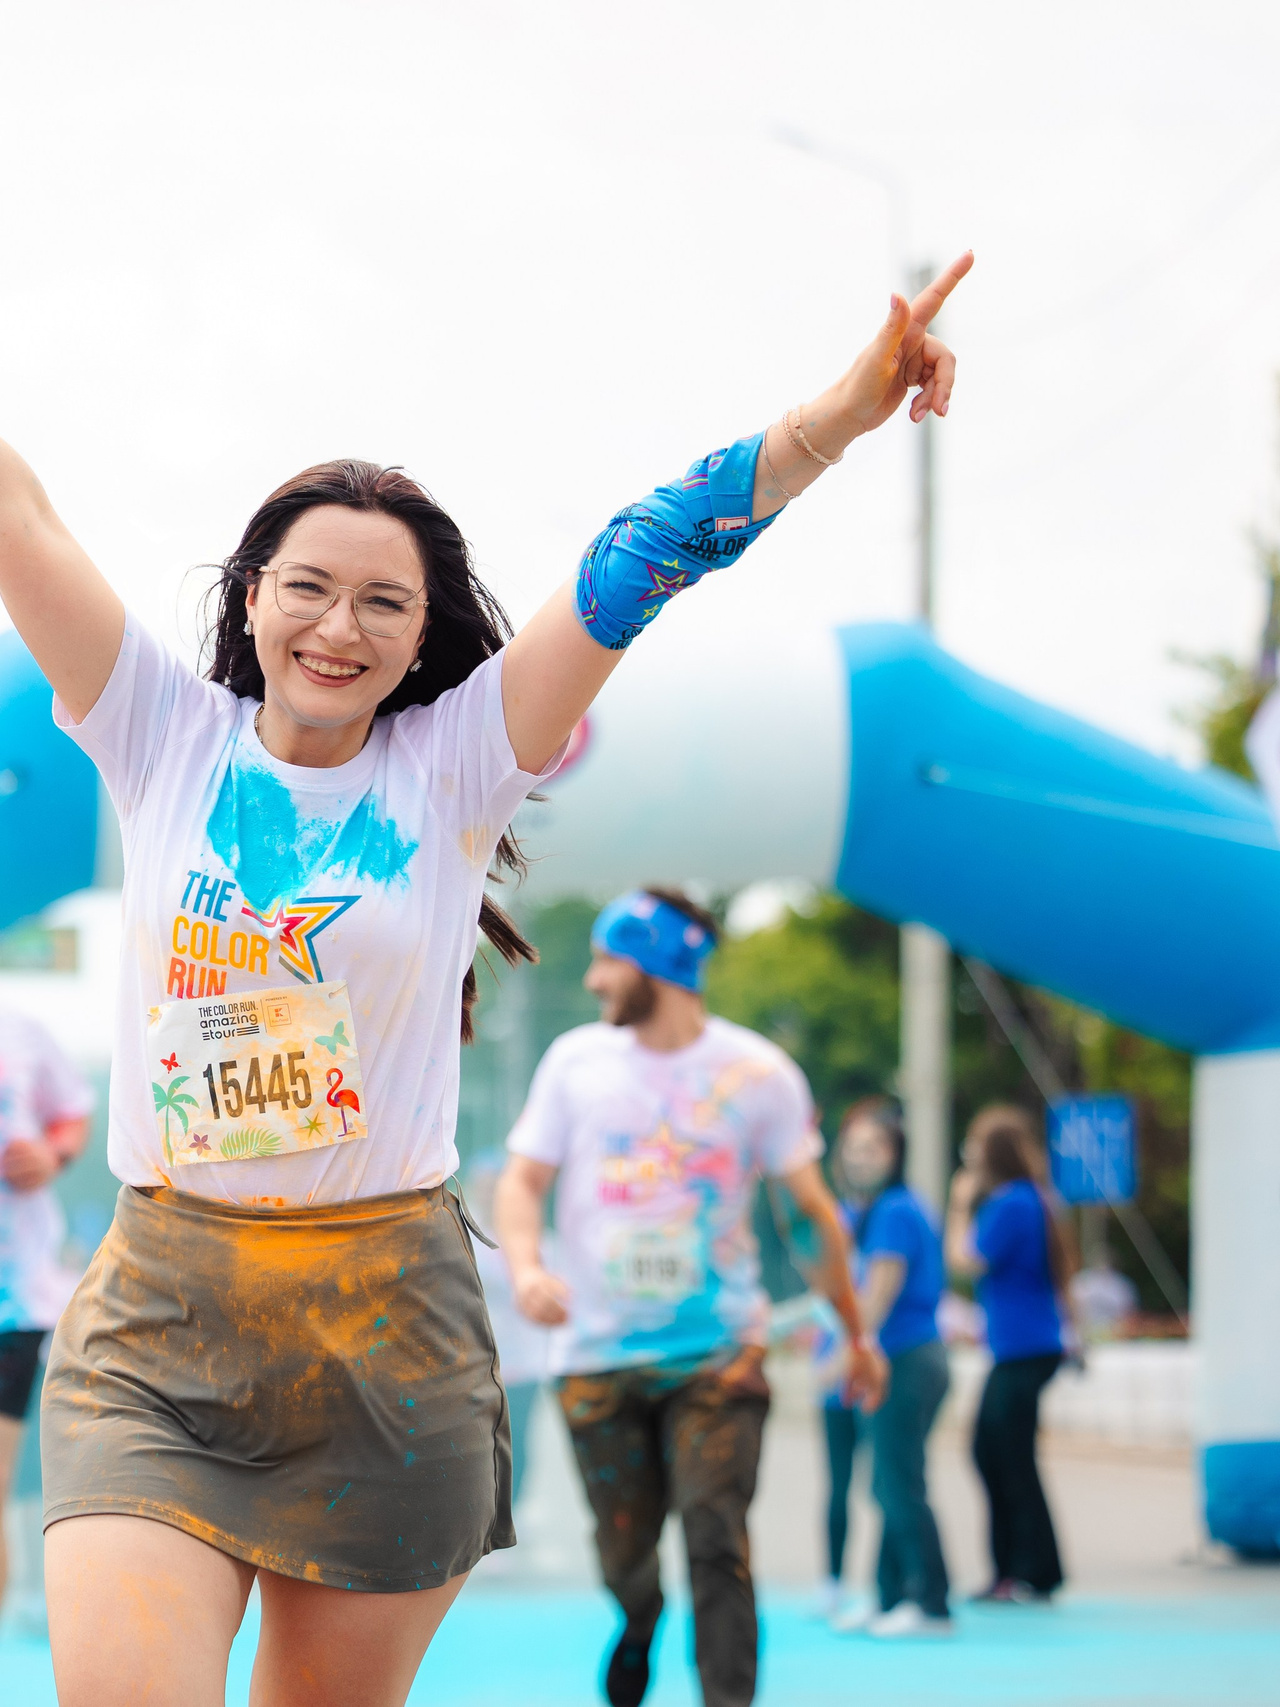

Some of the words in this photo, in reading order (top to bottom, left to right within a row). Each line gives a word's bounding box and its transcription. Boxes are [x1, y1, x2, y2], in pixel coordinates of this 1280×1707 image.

[180, 870, 237, 922] THE
[172, 915, 270, 976] COLOR
[167, 956, 227, 1000] RUN
[198, 1006, 213, 1018] THE
[213, 1002, 239, 1016] COLOR
[200, 1013, 258, 1029] amazing
[209, 1029, 236, 1040] tour
[202, 1050, 312, 1120] 15445
